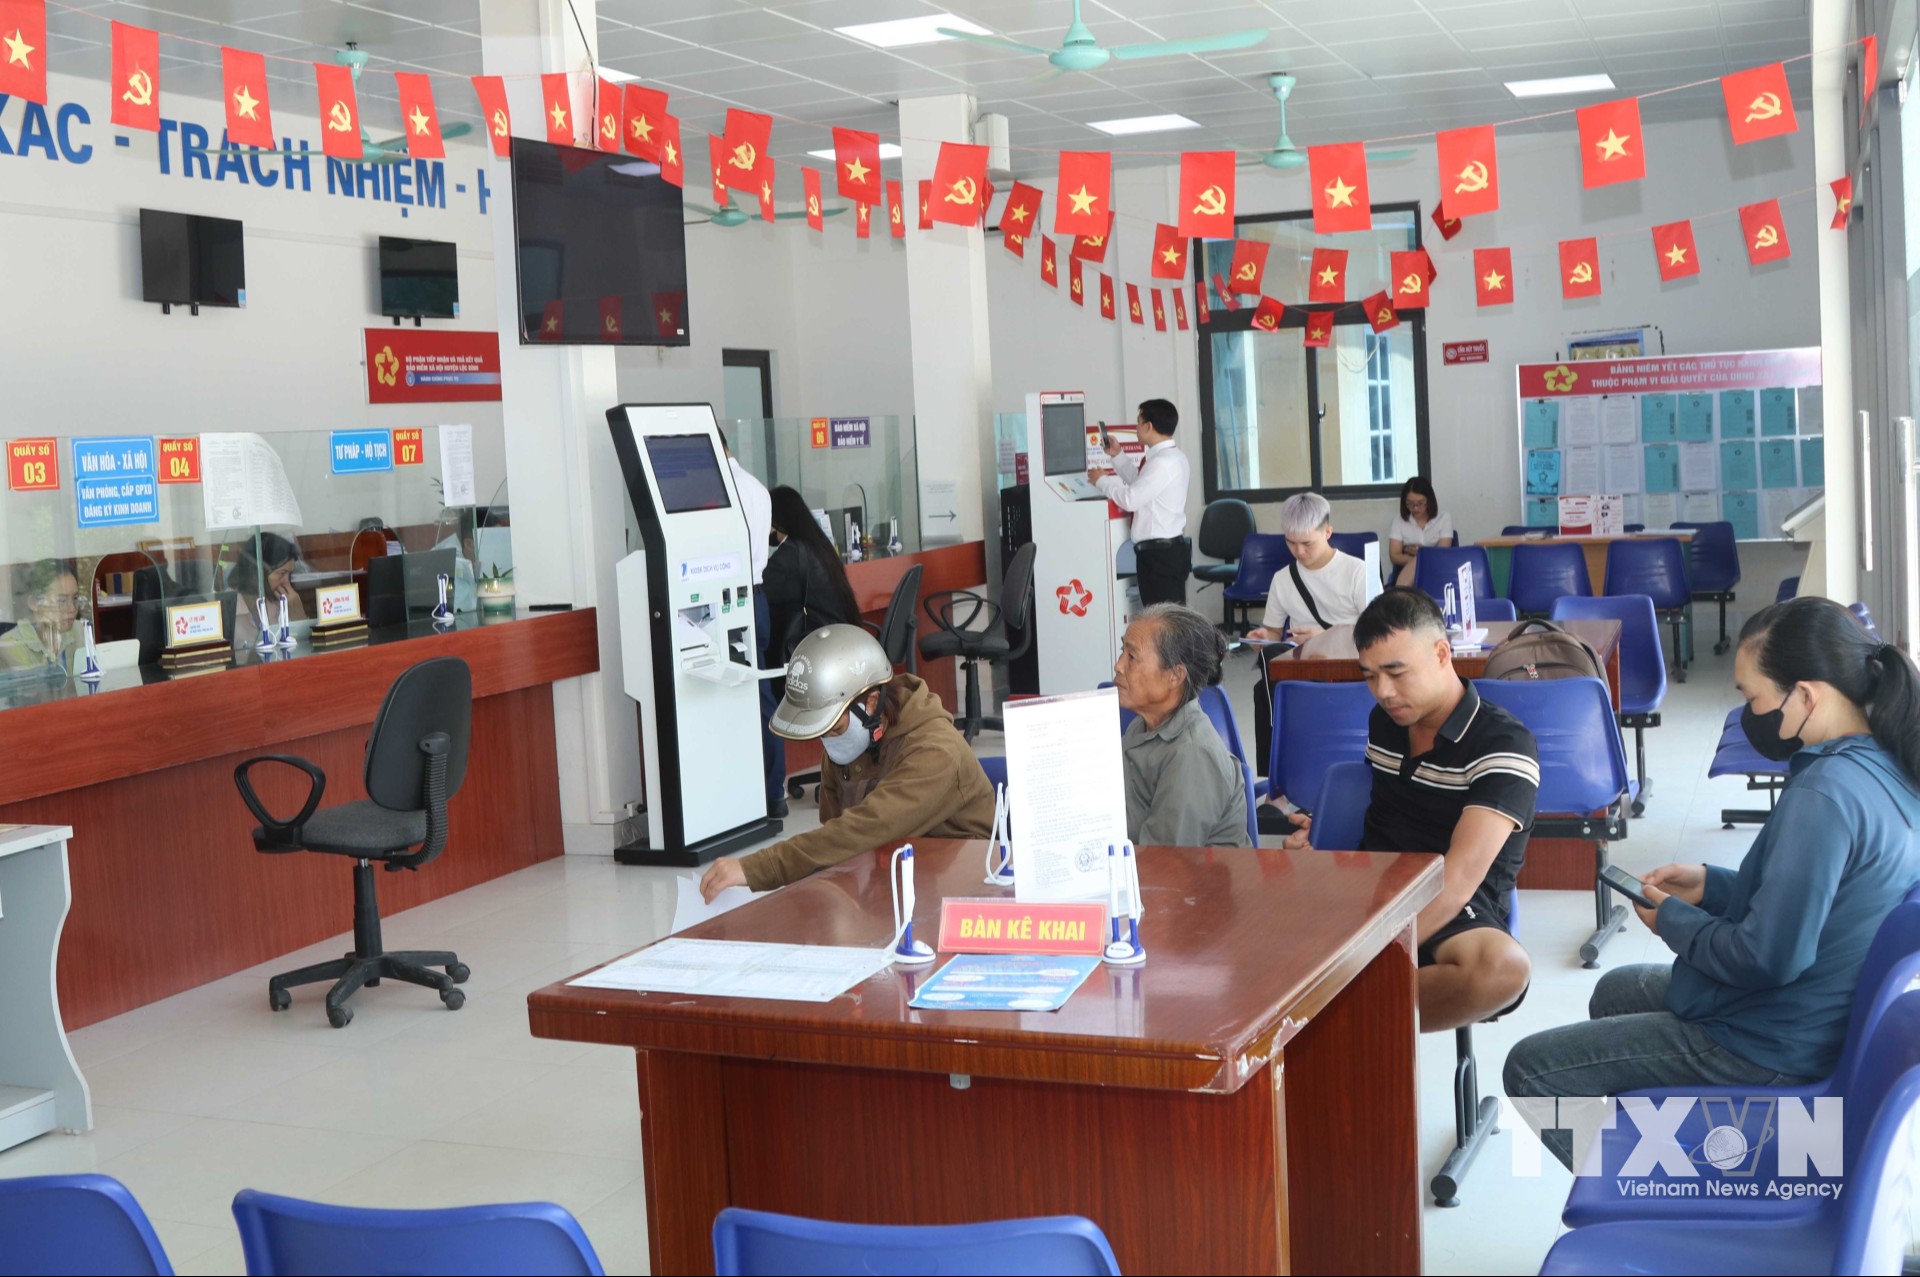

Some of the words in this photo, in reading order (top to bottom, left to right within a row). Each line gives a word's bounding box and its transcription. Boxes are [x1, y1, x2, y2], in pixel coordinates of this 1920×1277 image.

[82, 452, 99, 472] VĂN
[100, 450, 116, 471] HÓA
[122, 450, 134, 470] XÃ
[134, 450, 148, 473] HỘI
[402, 444, 416, 462] 07
[23, 462, 46, 484] 03
[170, 456, 190, 477] 04
[114, 503, 130, 516] KINH
[130, 502, 152, 514] DOANH
[960, 914, 1002, 940] BÀN
[1007, 915, 1032, 940] KÊ
[1038, 920, 1086, 941] KHAI
